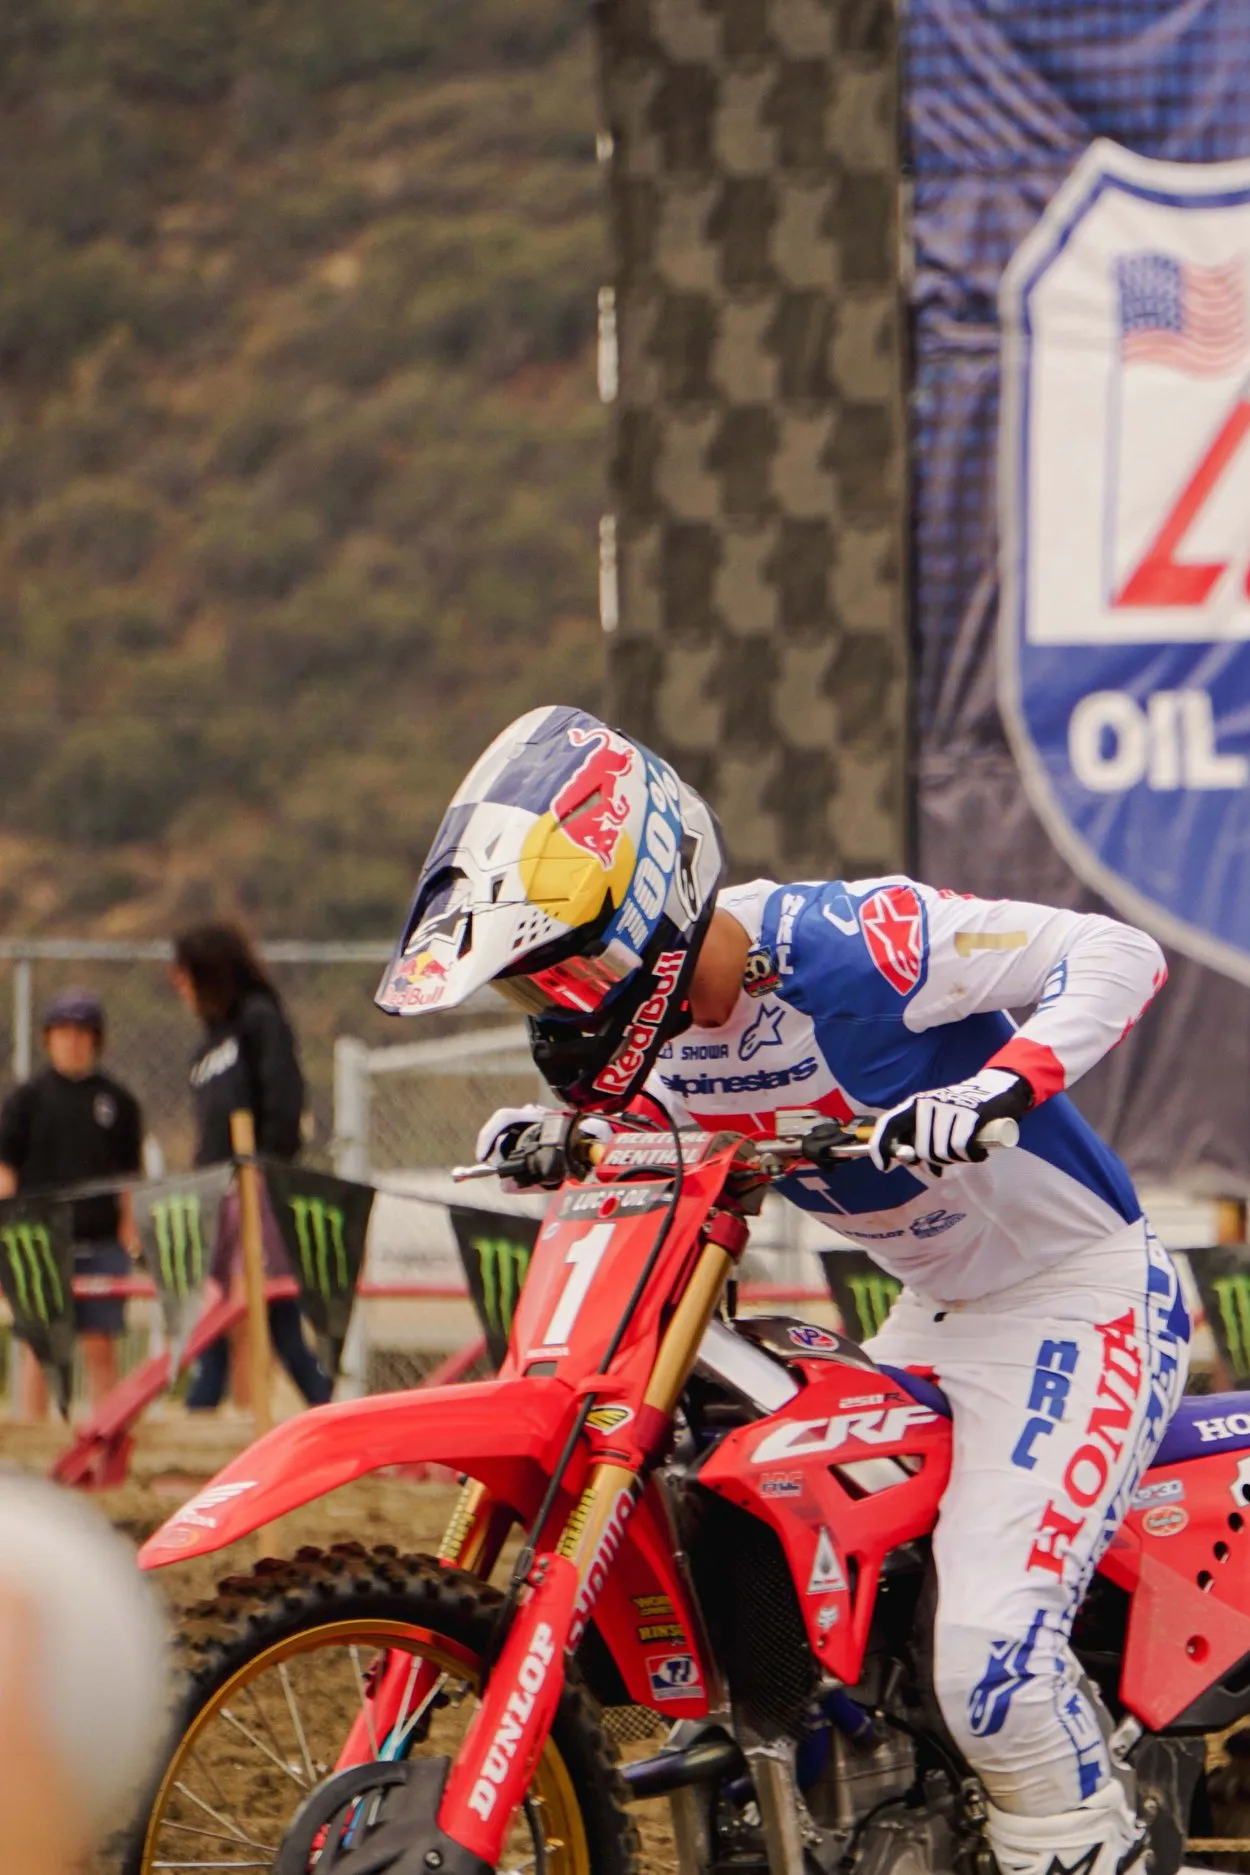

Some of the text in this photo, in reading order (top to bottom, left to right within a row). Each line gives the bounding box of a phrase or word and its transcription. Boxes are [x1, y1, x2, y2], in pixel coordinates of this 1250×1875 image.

[1067, 688, 1249, 792] OIL
[953, 930, 1029, 958] 1
[405, 986, 445, 1006] Bull
[593, 950, 687, 1096] Red Bull
[681, 1044, 729, 1061] SHOWA
[542, 1222, 617, 1346] 1
[751, 1404, 939, 1464] CRF
[467, 1621, 557, 1823] DUNLOP
